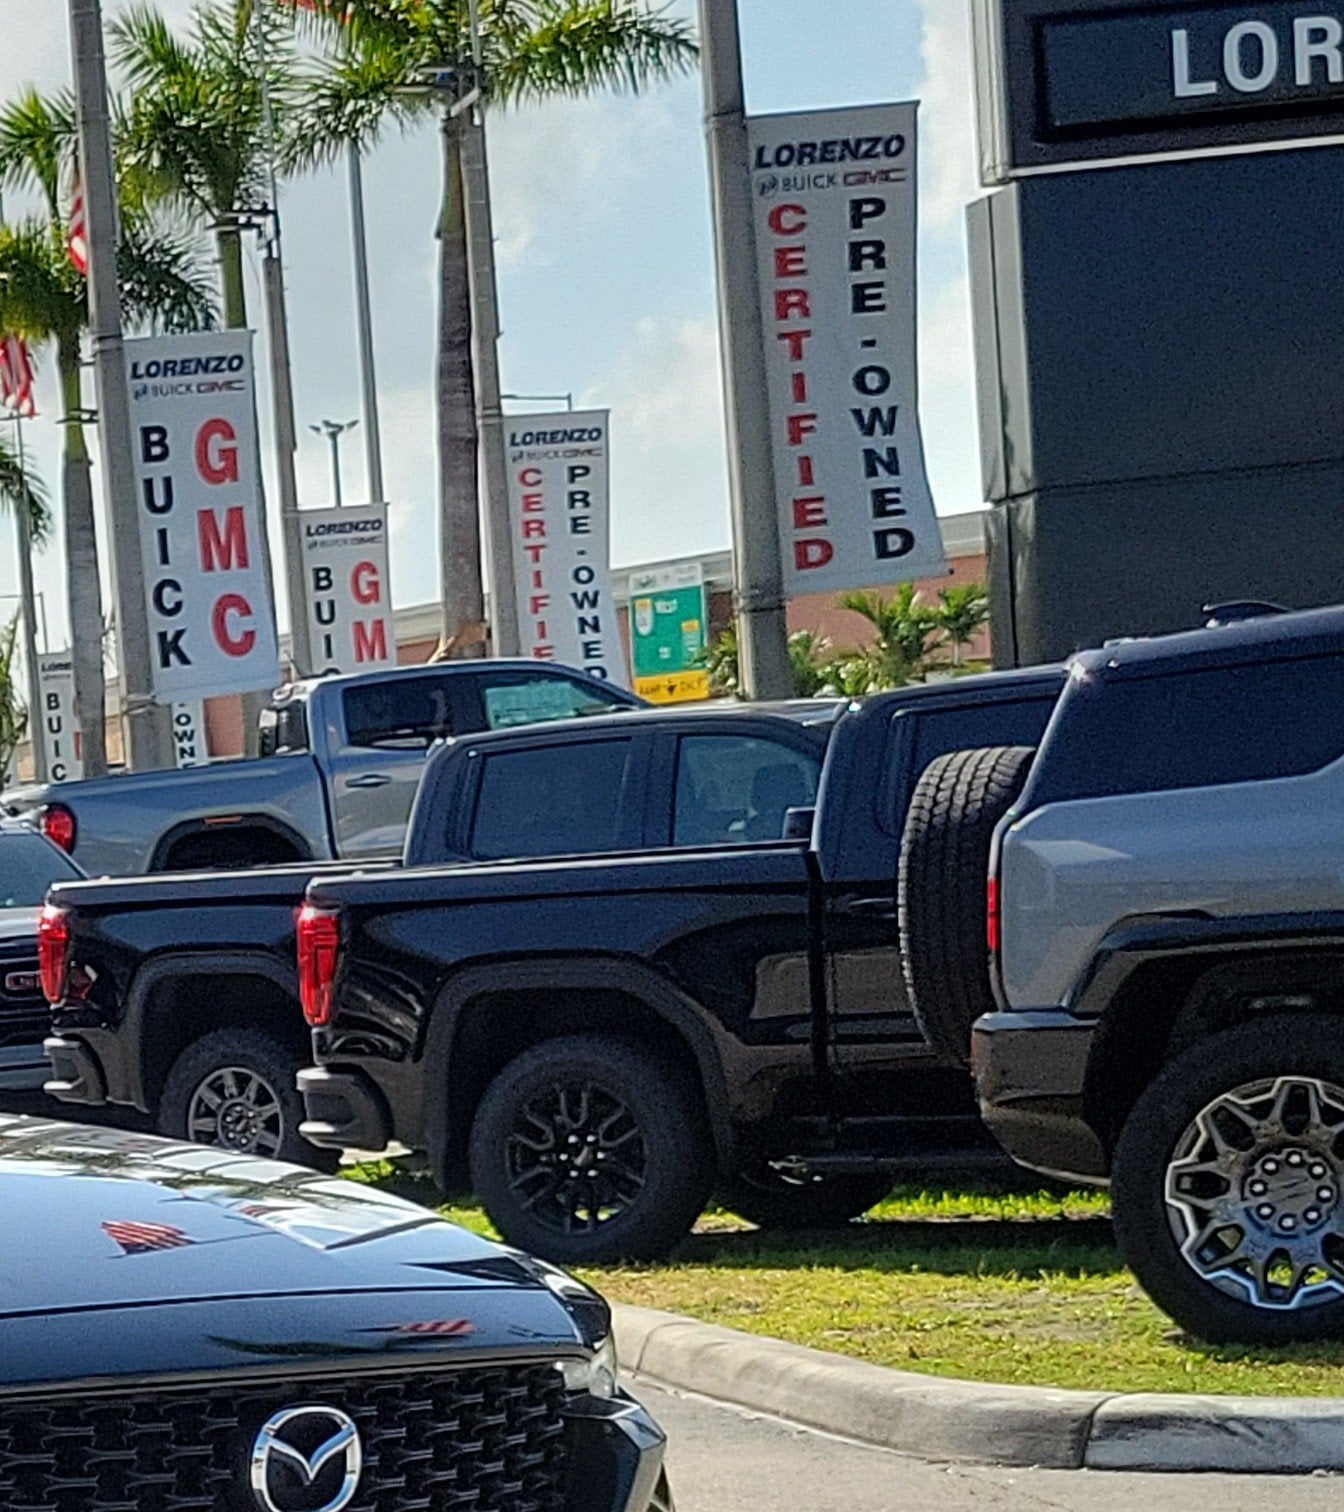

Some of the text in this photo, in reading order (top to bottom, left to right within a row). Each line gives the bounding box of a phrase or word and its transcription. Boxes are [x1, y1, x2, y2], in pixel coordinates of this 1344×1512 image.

[1172, 16, 1343, 97] LOR
[755, 134, 905, 168] LORENZO
[782, 168, 909, 192] BUICK GMC
[131, 354, 244, 379] LORENZO
[768, 203, 834, 570] CERTIFIED
[509, 427, 603, 447] LORENZO
[139, 425, 192, 669] BUICK
[195, 417, 256, 658] GMC
